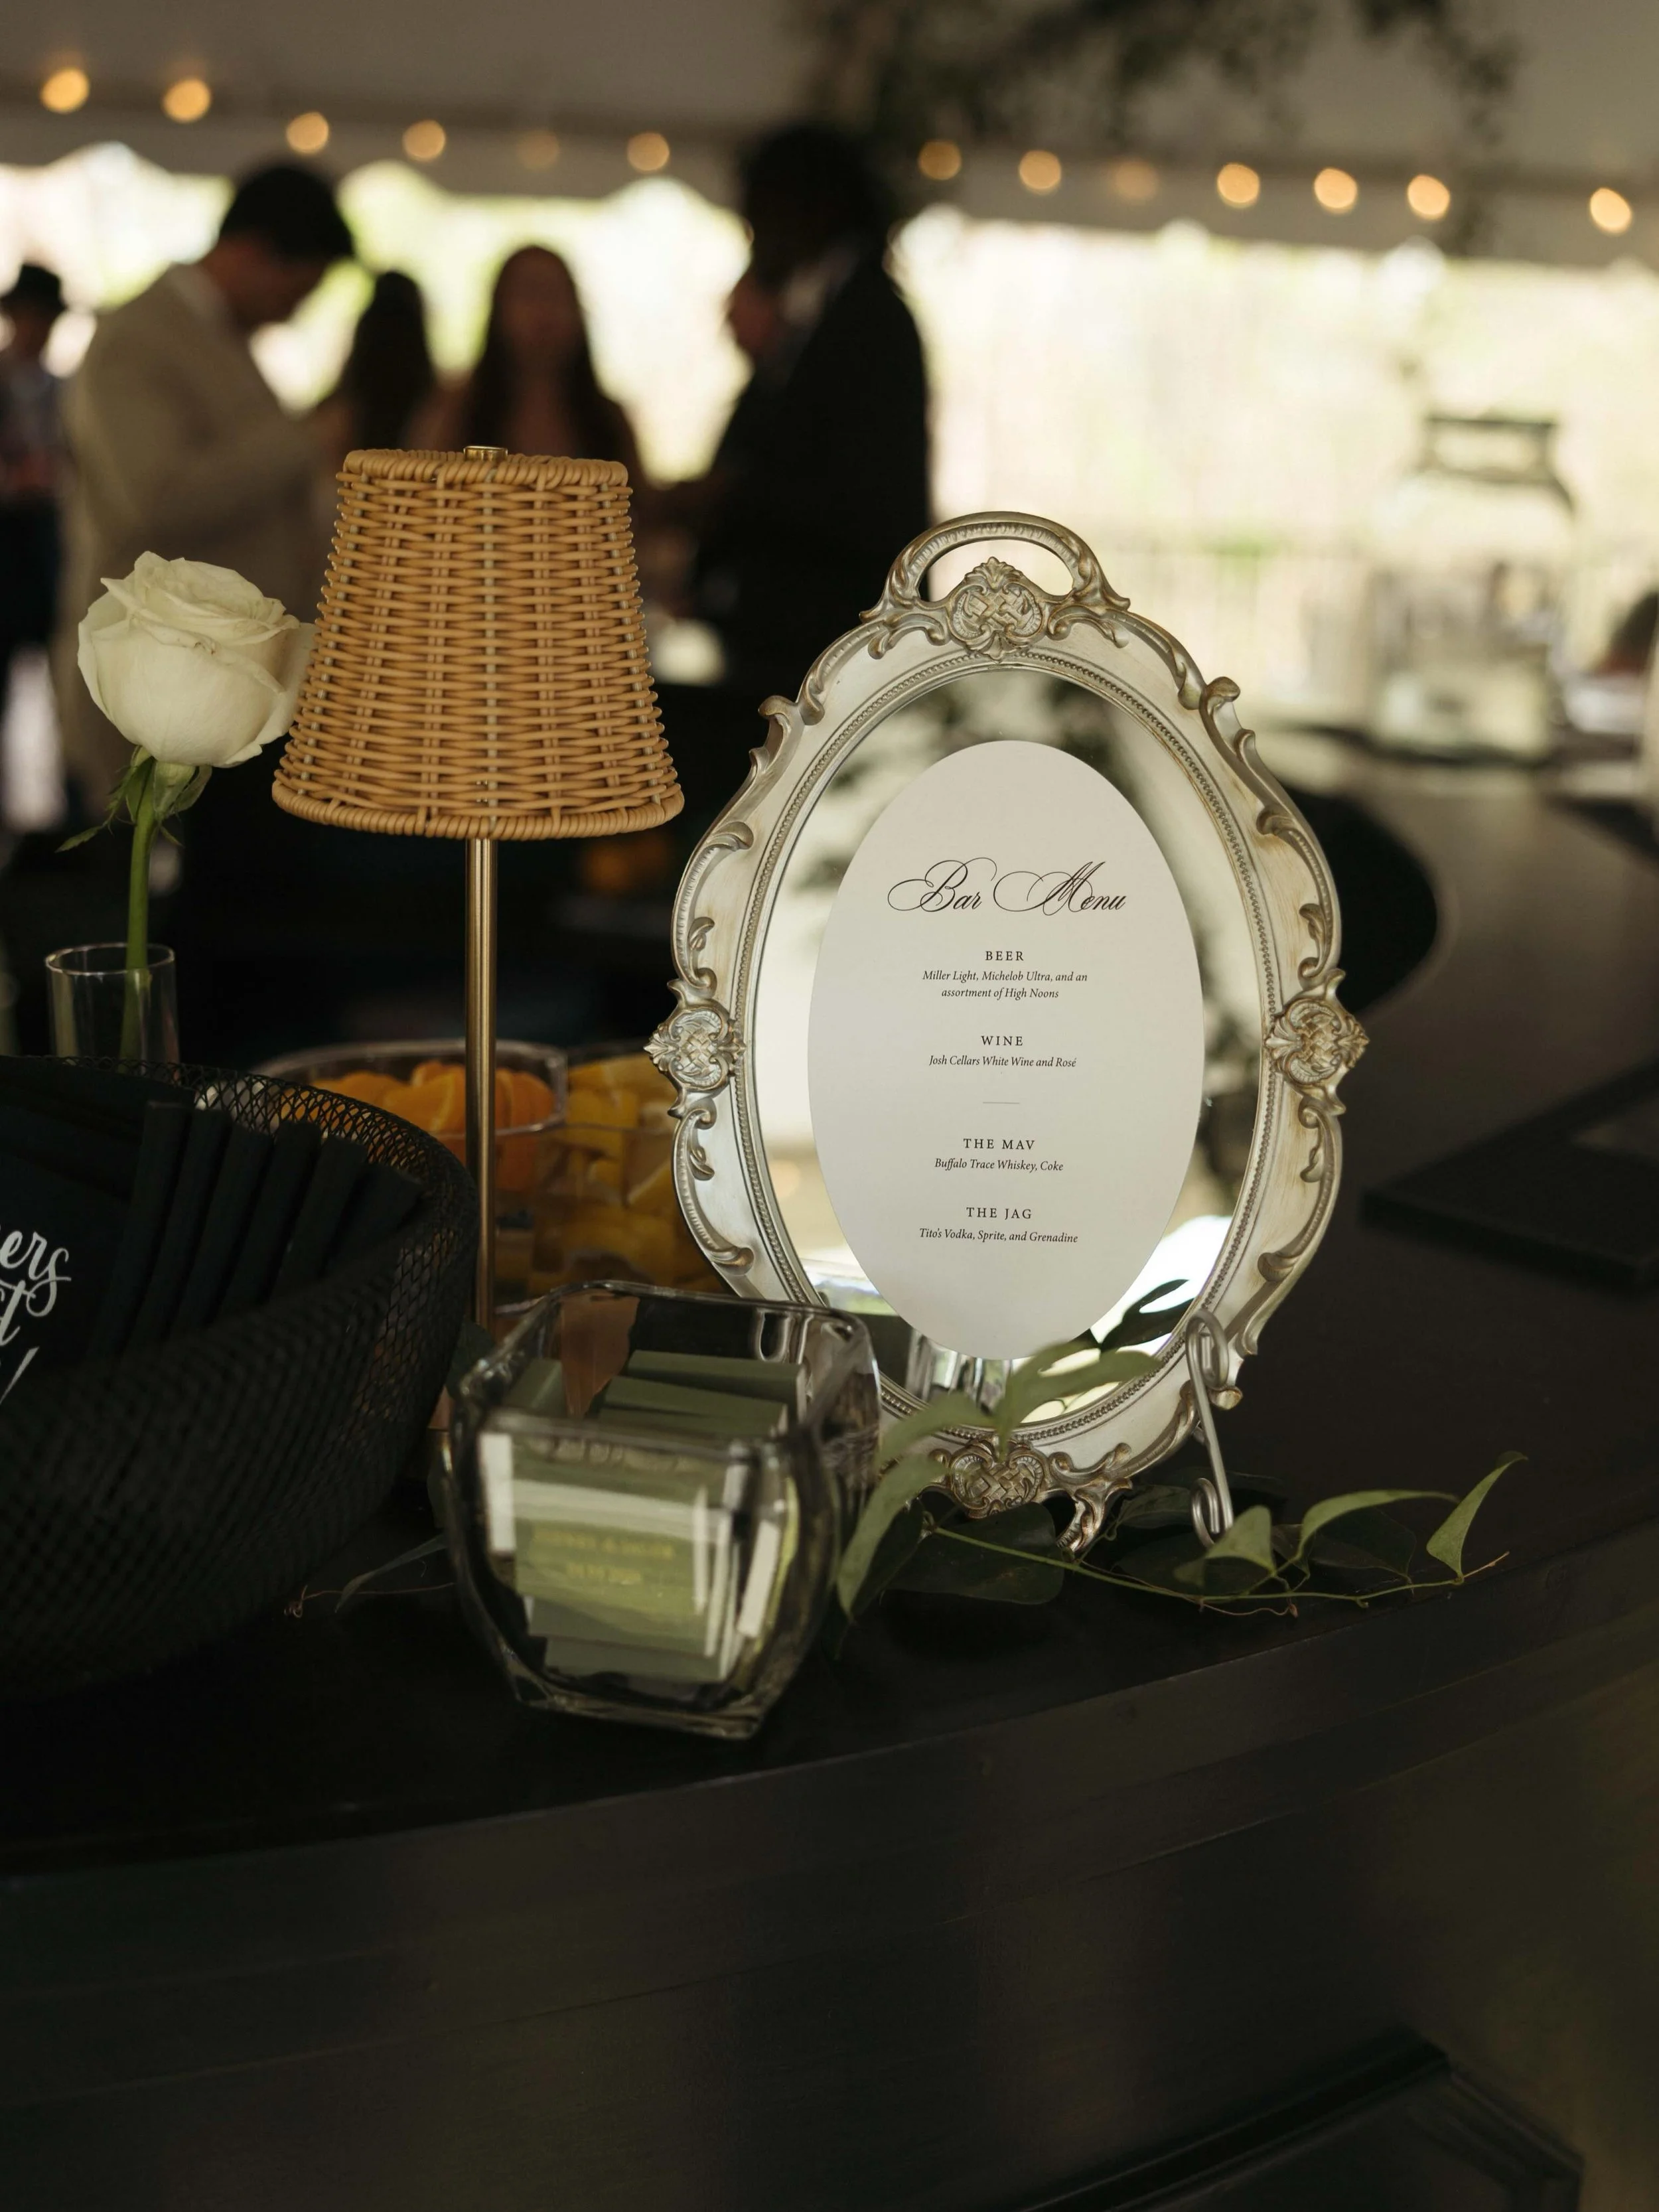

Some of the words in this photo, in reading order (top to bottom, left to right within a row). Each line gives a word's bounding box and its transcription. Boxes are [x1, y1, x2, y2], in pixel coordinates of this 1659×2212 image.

[887, 857, 997, 912] Bar
[993, 861, 1127, 916] Menu
[985, 951, 1024, 961] BEER
[922, 970, 951, 980] Miller
[952, 970, 978, 984] Light,
[982, 970, 1023, 981] Michelob
[1027, 971, 1052, 982] Ultra,
[1056, 972, 1074, 981] and
[993, 988, 1005, 1001] of
[1005, 988, 1027, 1001] High
[1029, 988, 1058, 997] Noons
[981, 1035, 1023, 1046] WINE
[929, 1055, 947, 1066] Josh
[950, 1055, 979, 1065] Cellars
[983, 1055, 1009, 1066] White
[1011, 1057, 1034, 1067] Wine
[1036, 1057, 1054, 1067] and
[1056, 1057, 1076, 1067] Rosé
[964, 1138, 994, 1149] THE
[1002, 1140, 1035, 1150] MAV
[934, 1158, 967, 1171] Buffalo
[970, 1159, 995, 1169] Trace
[997, 1159, 1037, 1173] Whiskey,
[1041, 1161, 1063, 1171] Coke
[966, 1207, 997, 1218] THE
[1005, 1209, 1031, 1220] JAG
[945, 1229, 975, 1240] Vodka,
[977, 1230, 1006, 1242] Sprite,
[1009, 1231, 1027, 1241] and
[1029, 1232, 1078, 1242] Grenadine
[0, 1230, 72, 1317] ers
